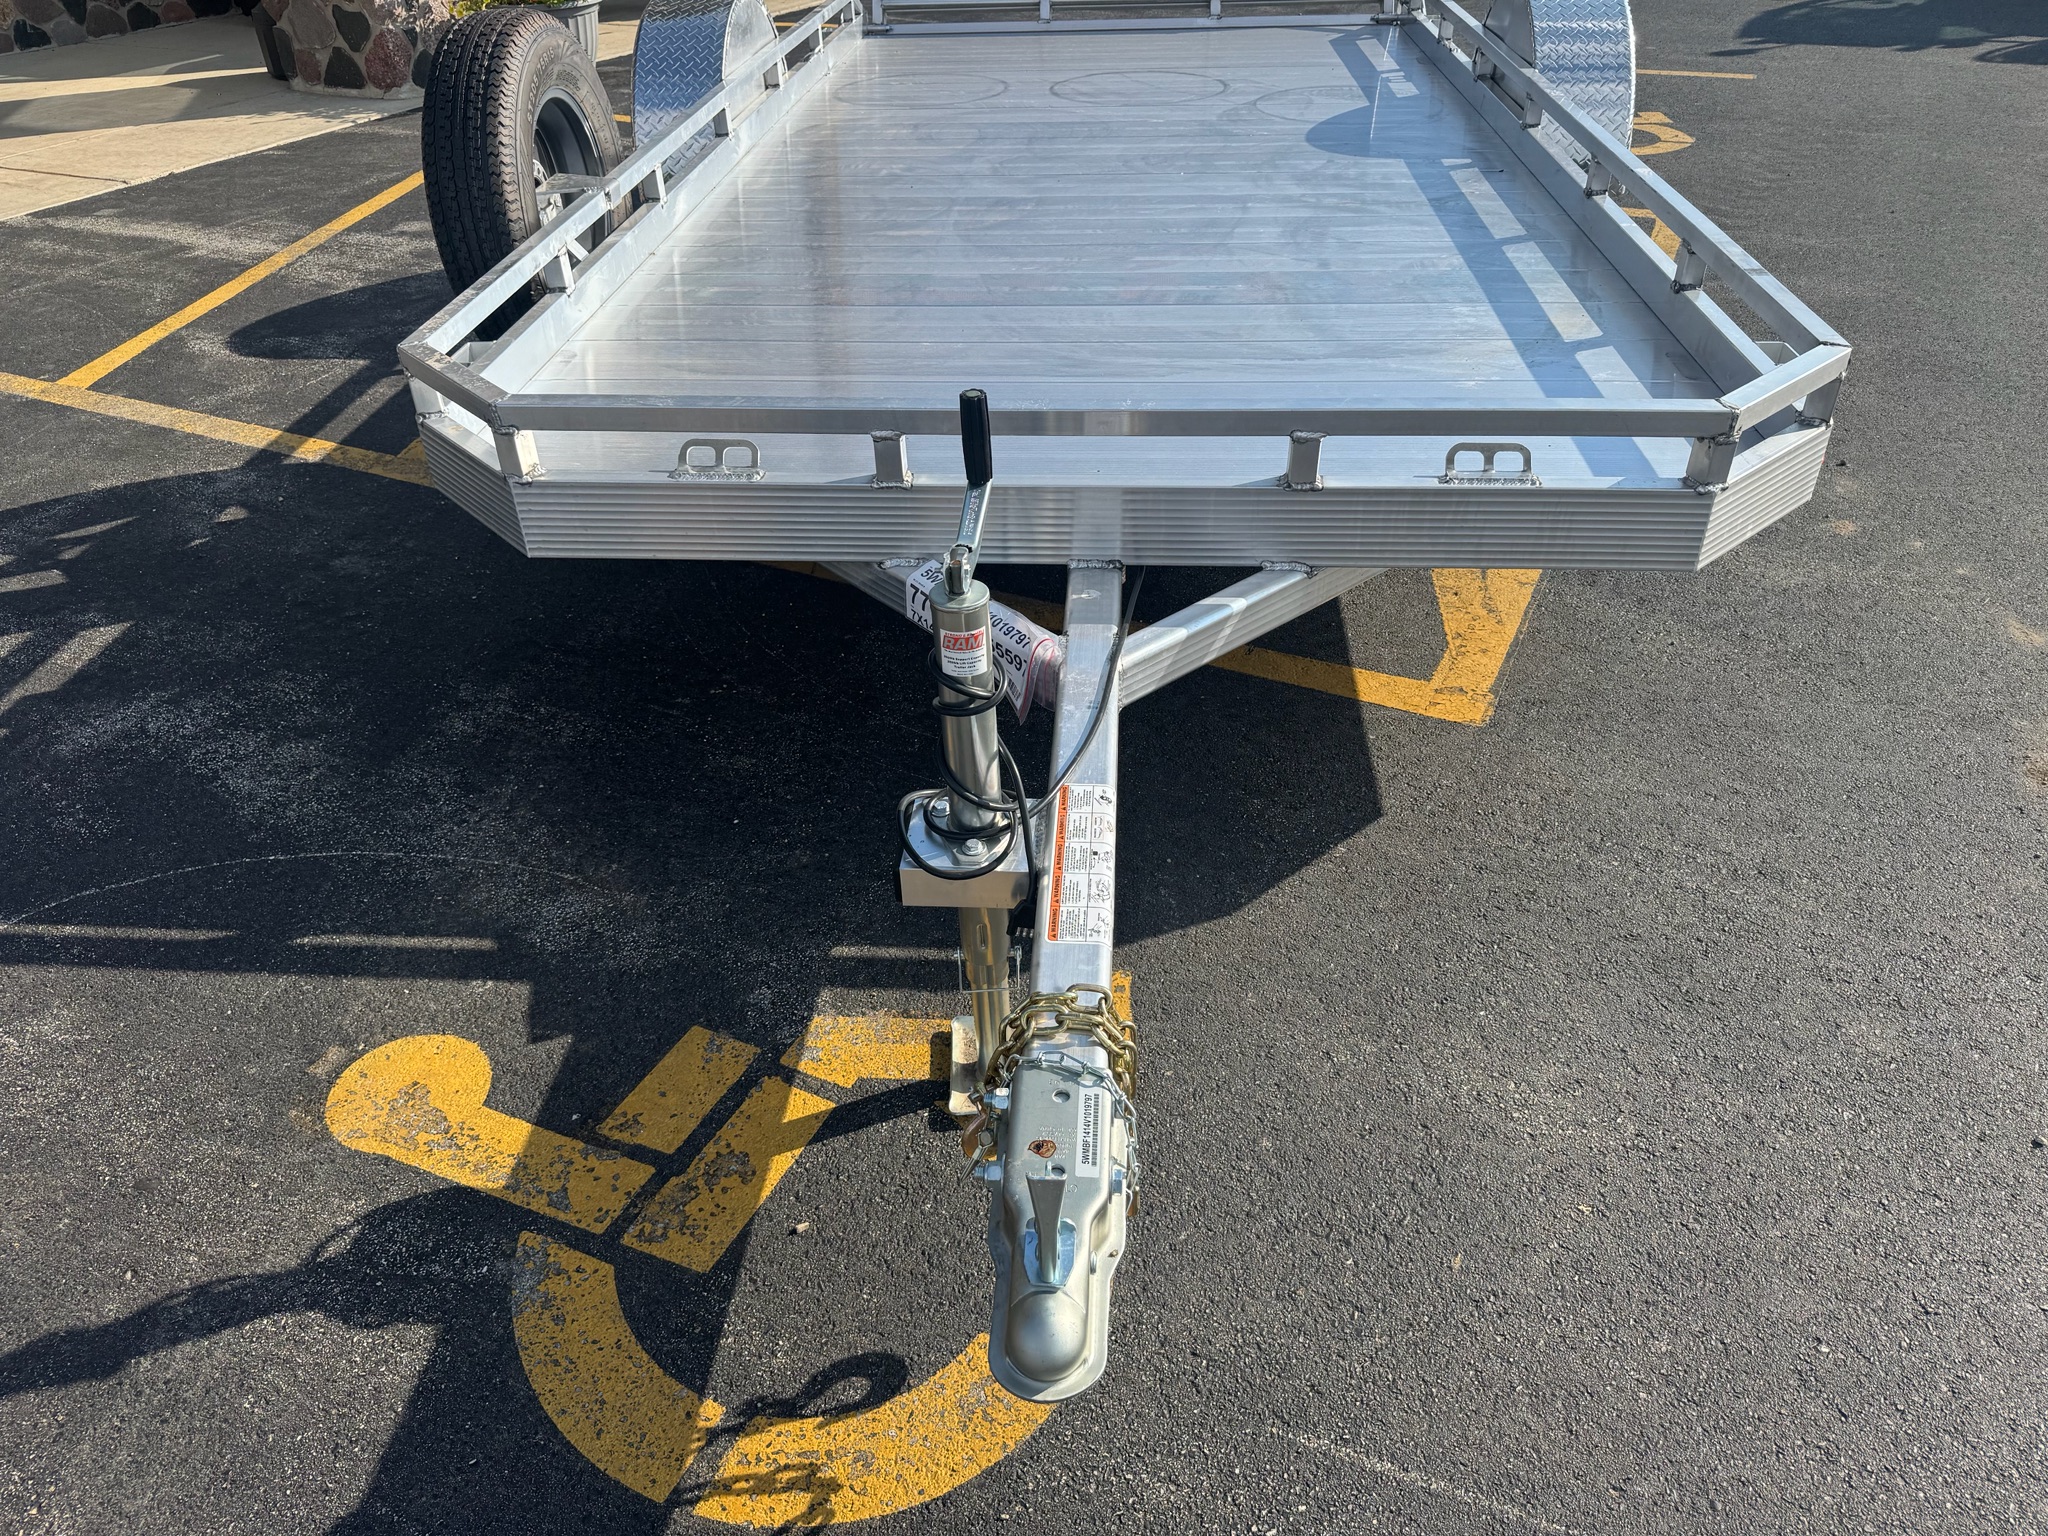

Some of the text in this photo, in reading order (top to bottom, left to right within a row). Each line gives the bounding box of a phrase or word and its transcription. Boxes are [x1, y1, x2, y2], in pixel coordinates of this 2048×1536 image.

[943, 634, 983, 650] RAM
[989, 612, 1031, 648] 1019797
[991, 638, 1028, 677] 5597
[1050, 908, 1058, 933] WARNING
[1081, 1093, 1094, 1166] 5WMBF1414V1019797
